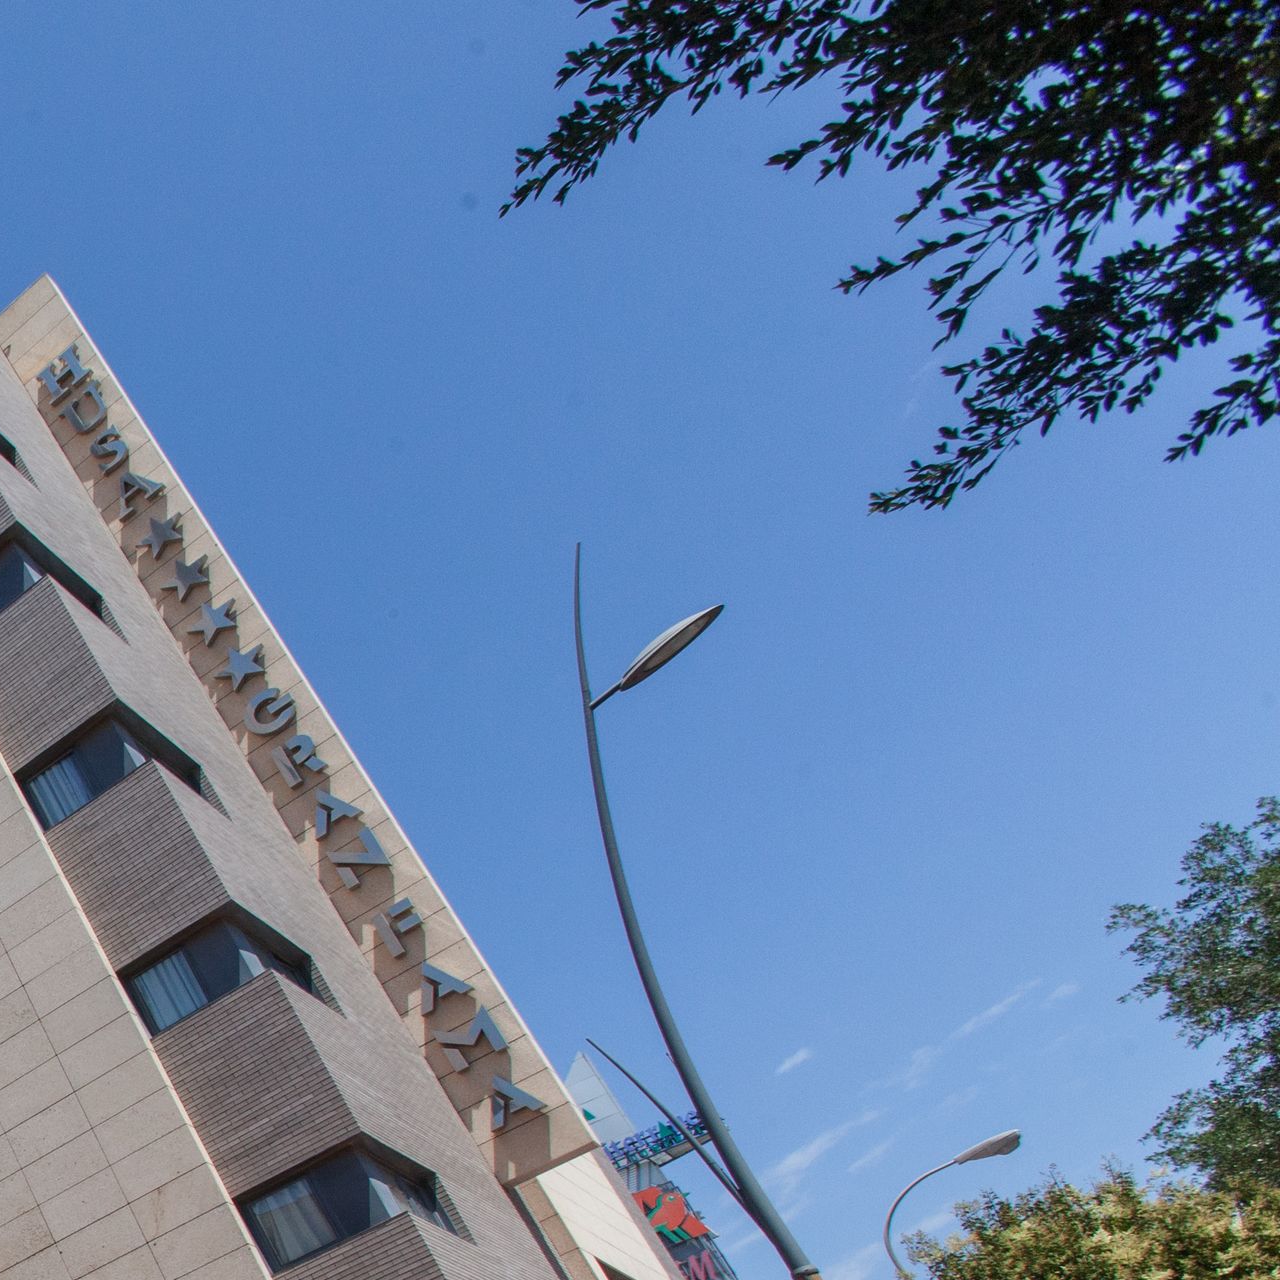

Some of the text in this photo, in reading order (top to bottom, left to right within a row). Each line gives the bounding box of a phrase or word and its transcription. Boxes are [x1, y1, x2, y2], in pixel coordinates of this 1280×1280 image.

[36, 343, 547, 1131] HUSA GRAN FAMA
